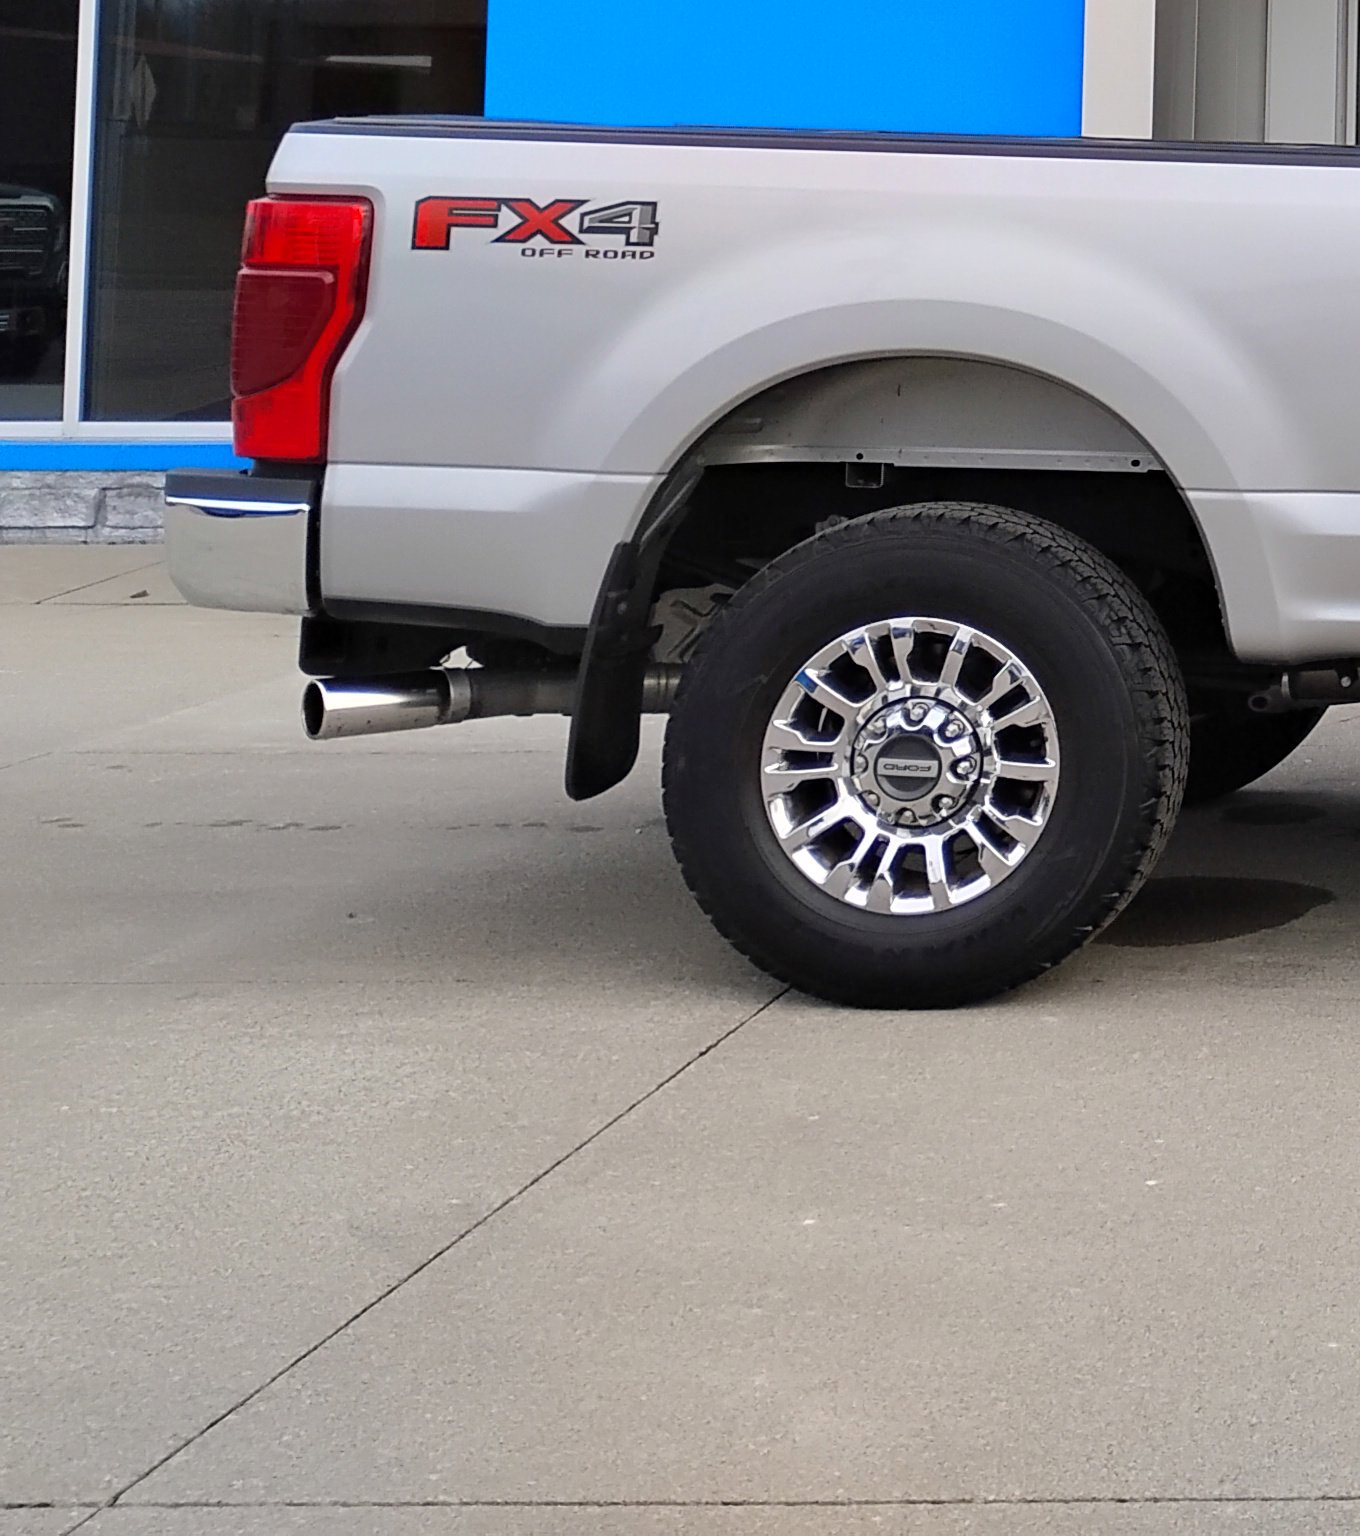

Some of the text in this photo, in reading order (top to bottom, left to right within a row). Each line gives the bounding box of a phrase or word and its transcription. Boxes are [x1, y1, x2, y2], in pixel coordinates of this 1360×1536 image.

[411, 195, 659, 251] FX4
[520, 247, 655, 260] OFF ROAD
[883, 763, 931, 772] FORD
